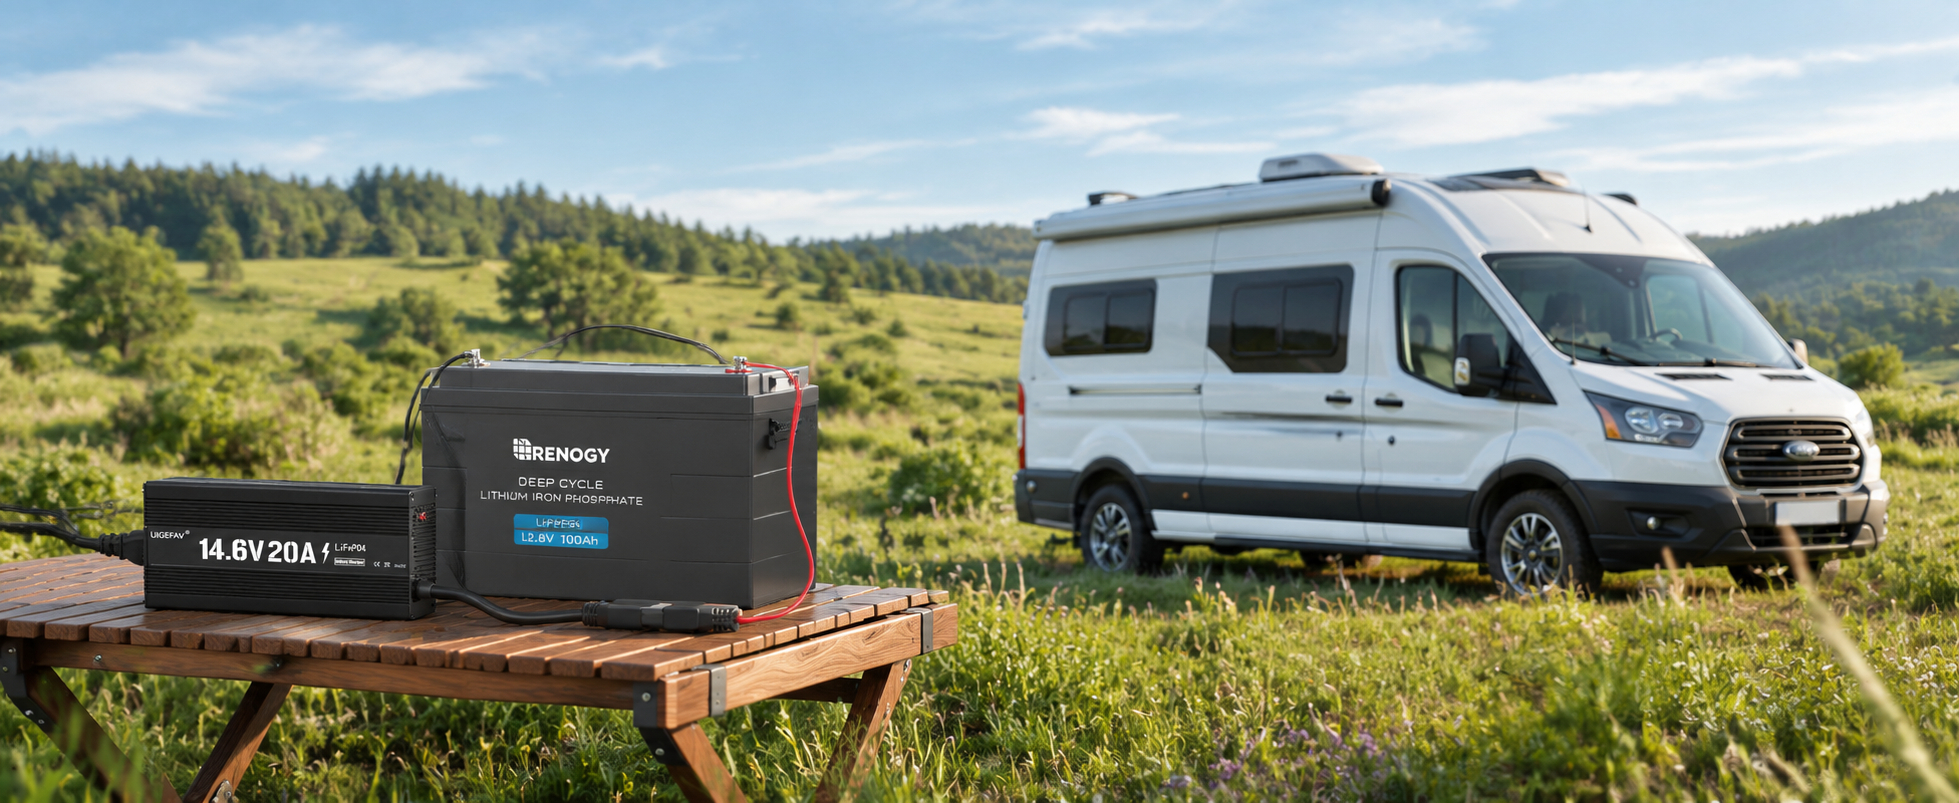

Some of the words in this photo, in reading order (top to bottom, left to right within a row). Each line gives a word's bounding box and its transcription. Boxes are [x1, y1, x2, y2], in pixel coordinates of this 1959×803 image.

[532, 446, 610, 463] RENOGY
[518, 477, 555, 488] DEEP
[559, 479, 603, 490] CYCLE
[480, 490, 528, 501] LITHIUM
[532, 492, 562, 502] IRON
[560, 534, 599, 546] 100Ah
[199, 538, 264, 562] 14.6V
[267, 540, 317, 564] 20A
